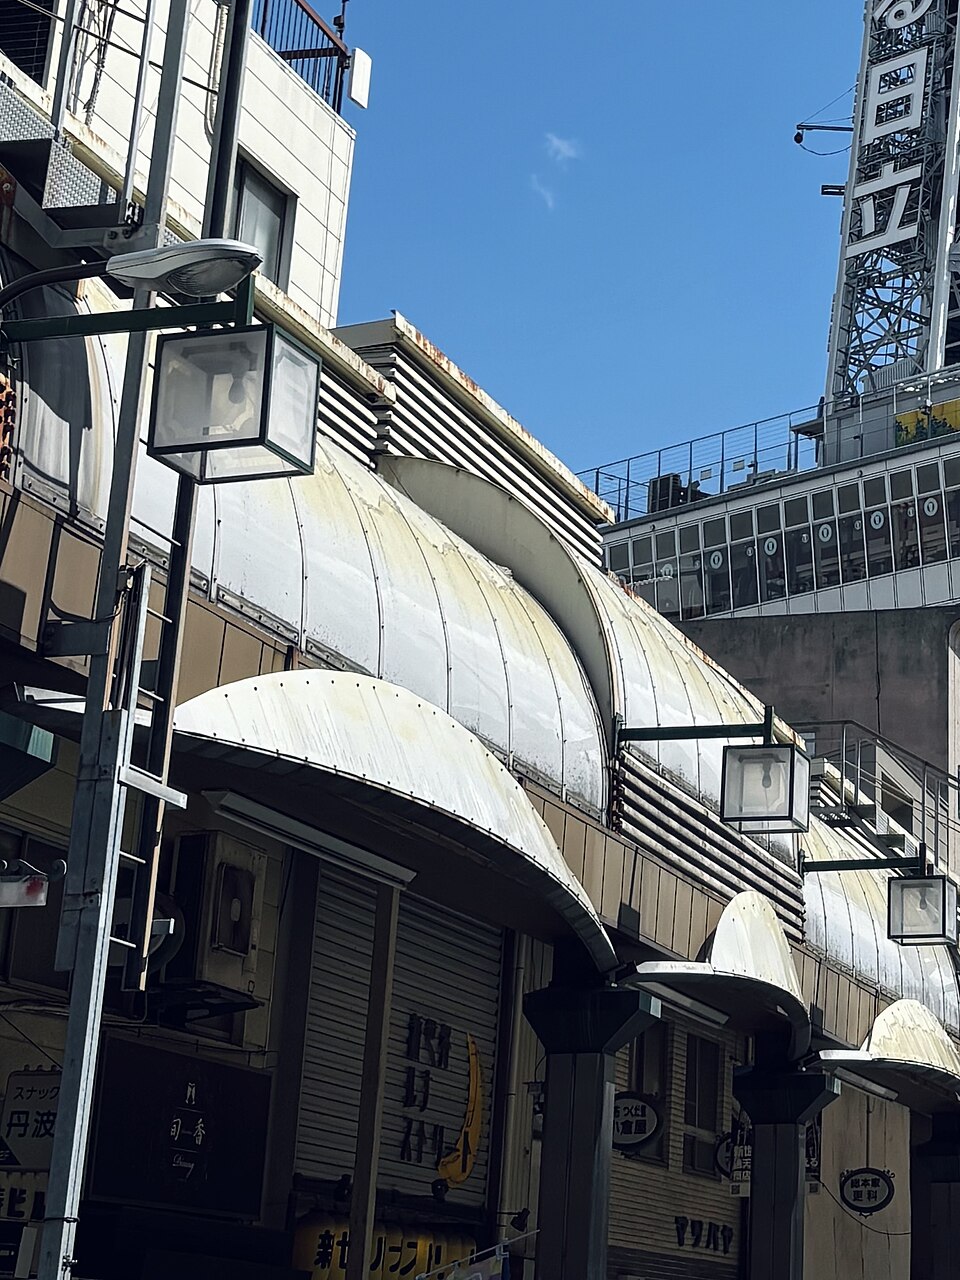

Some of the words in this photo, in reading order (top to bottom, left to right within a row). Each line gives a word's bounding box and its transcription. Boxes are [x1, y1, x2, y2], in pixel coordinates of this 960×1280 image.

[13, 1086, 60, 1100] スナック
[6, 1110, 57, 1138] 丹波
